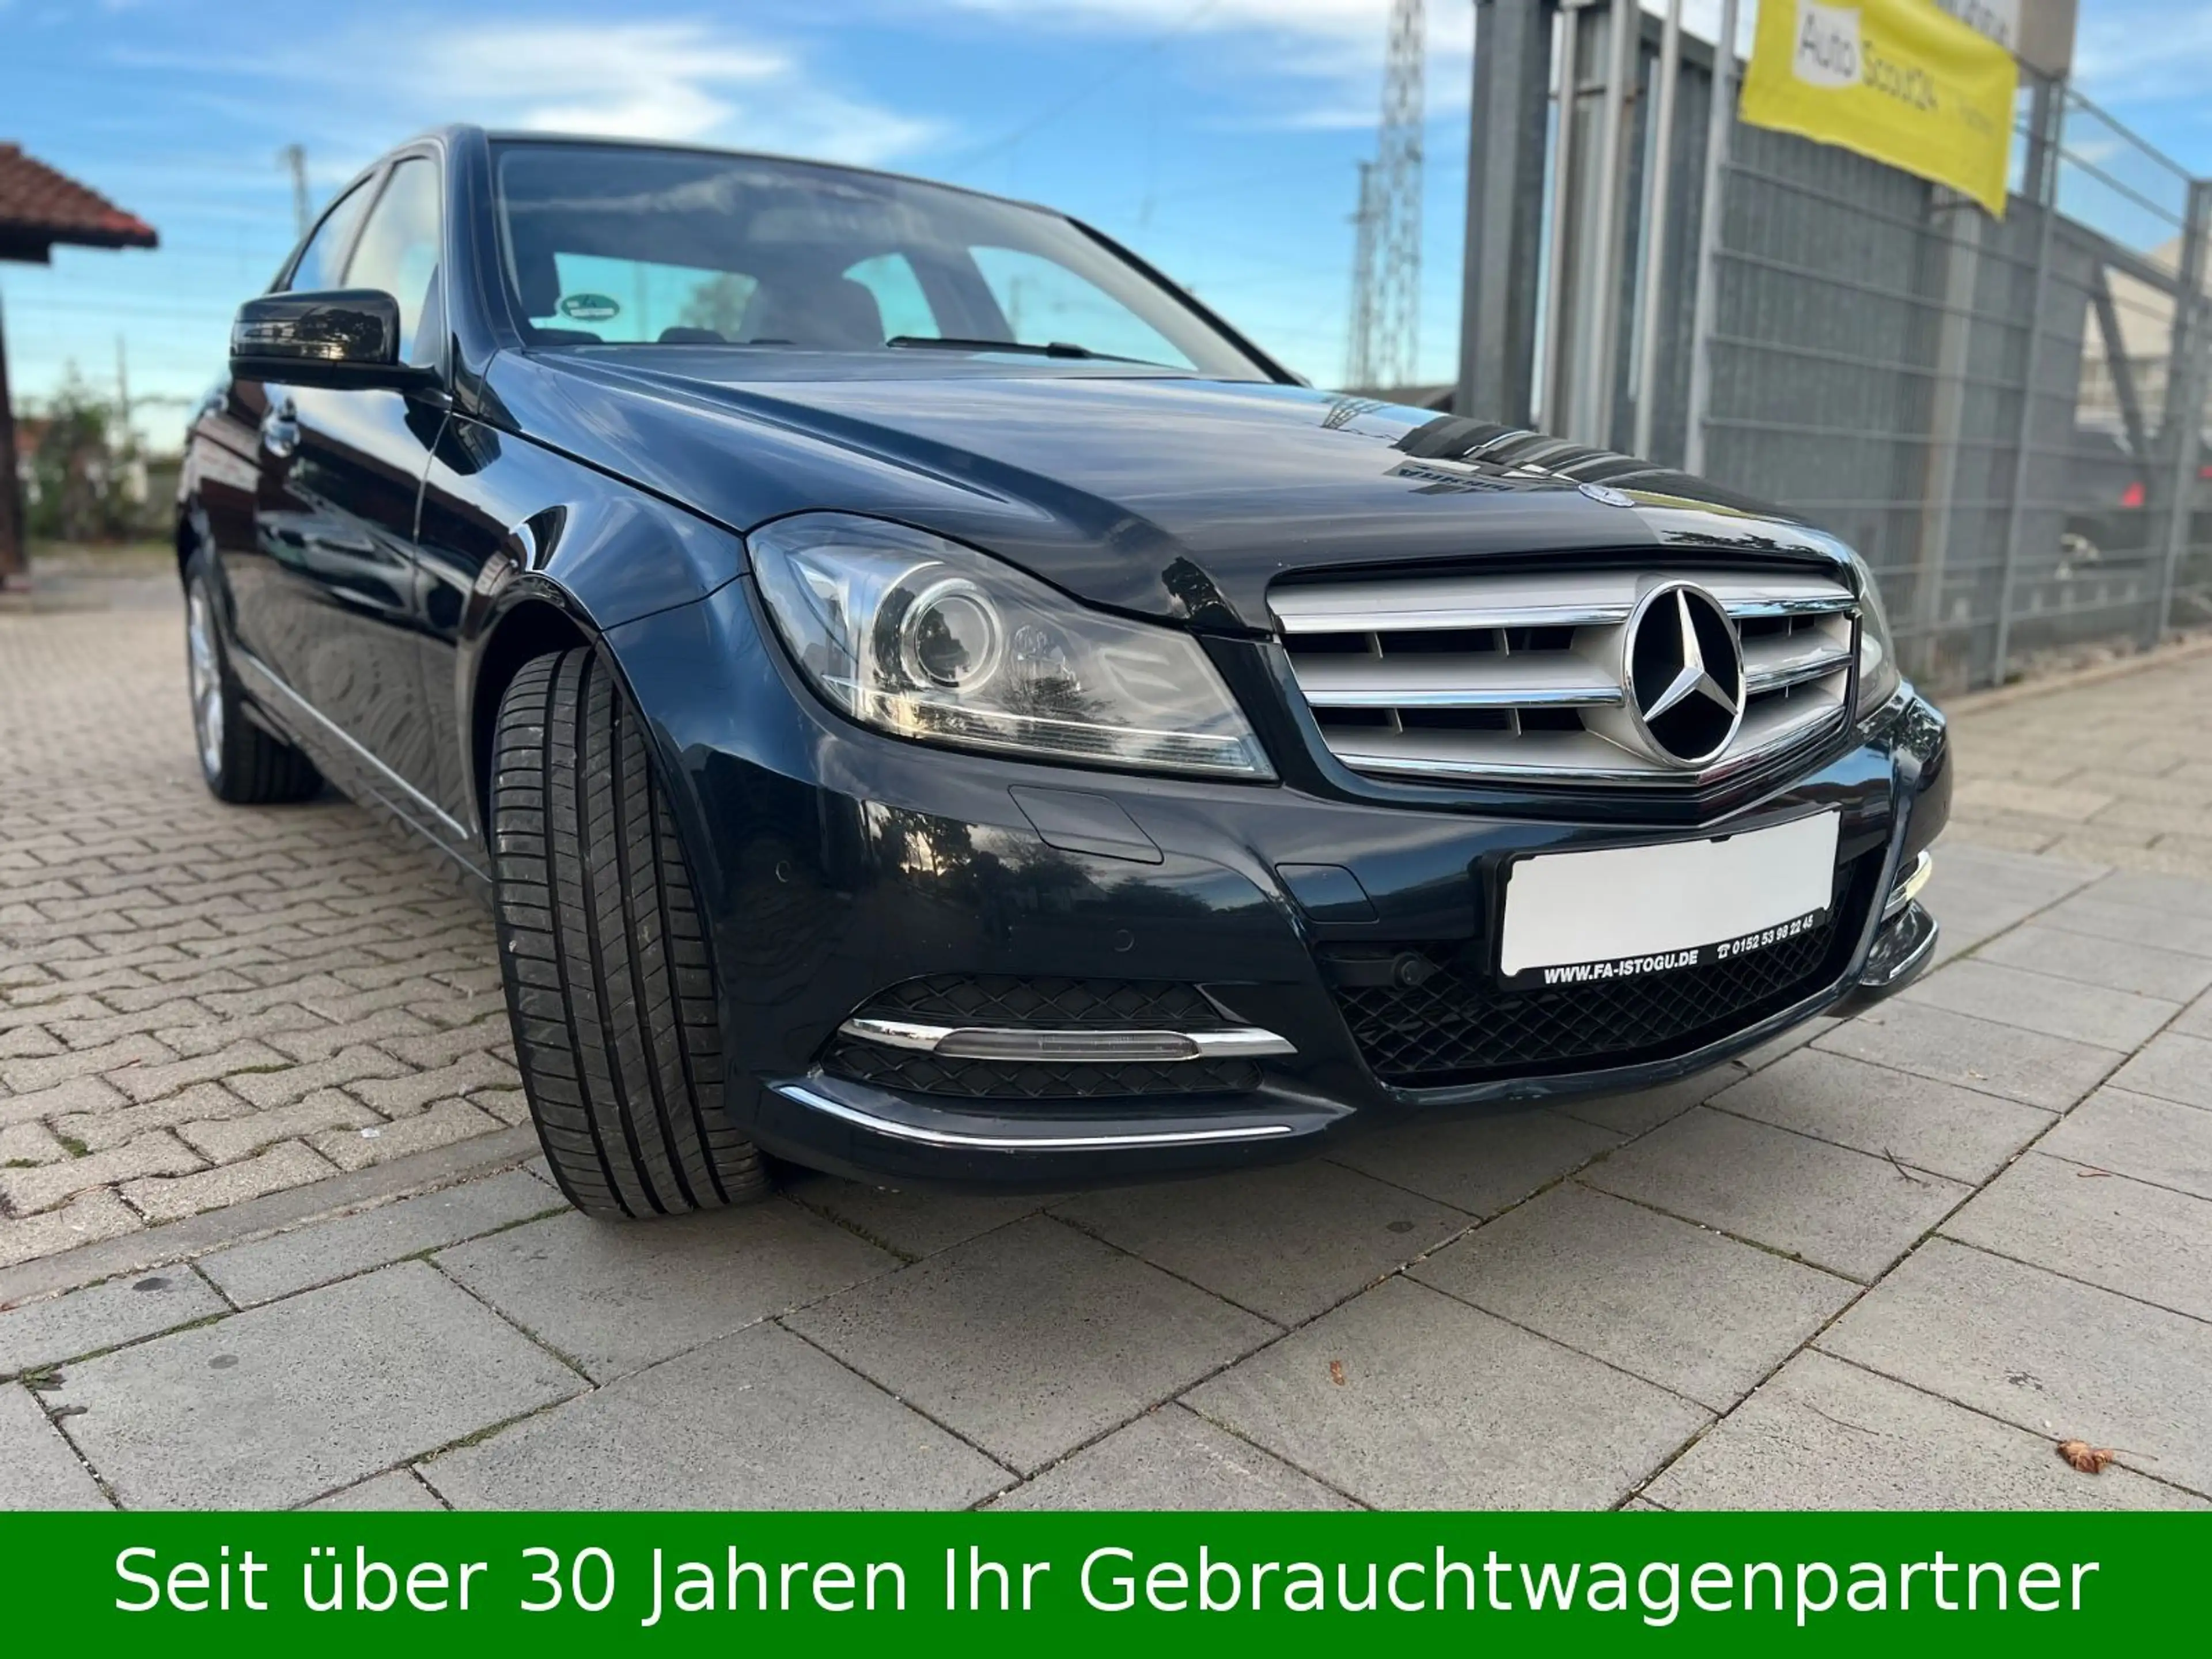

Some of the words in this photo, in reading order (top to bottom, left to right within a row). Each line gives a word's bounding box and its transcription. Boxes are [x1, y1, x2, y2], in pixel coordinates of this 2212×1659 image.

[1798, 13, 1856, 79] Auto
[1544, 949, 1699, 984] WWW.FA-ISTOGU.DE
[1732, 934, 1760, 955] 0152
[1761, 929, 1774, 946] 53
[1789, 919, 1802, 936] 22
